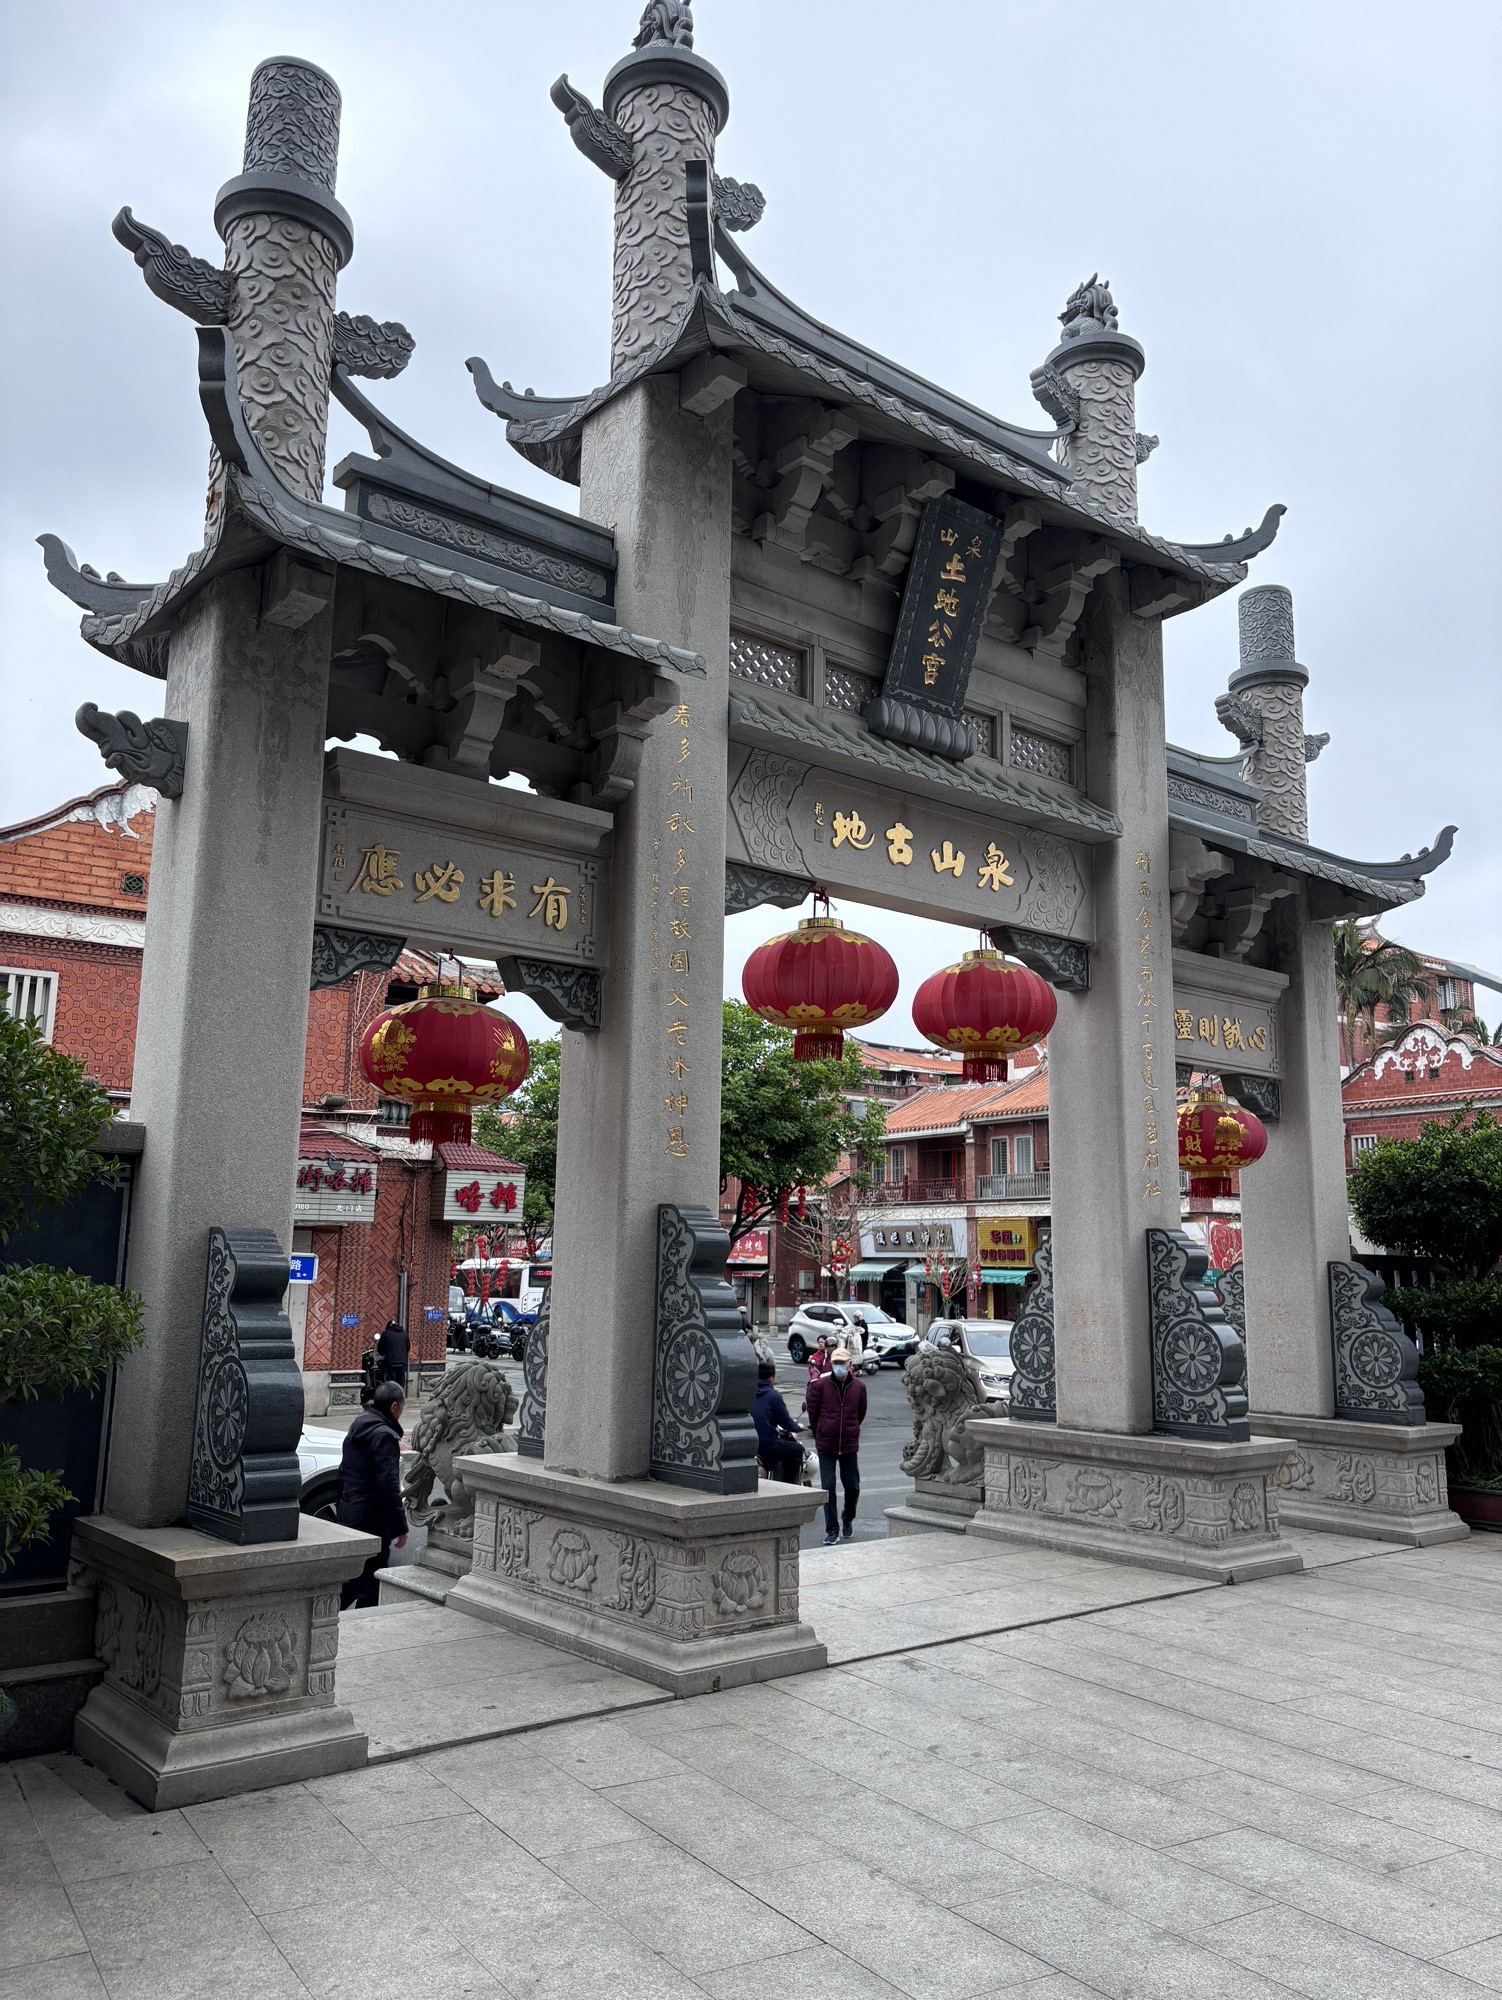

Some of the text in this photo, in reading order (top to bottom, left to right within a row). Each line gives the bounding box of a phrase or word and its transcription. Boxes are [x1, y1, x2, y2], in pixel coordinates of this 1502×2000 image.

[348, 844, 572, 931] 有求必應
[1174, 1009, 1267, 1052] 心誠則靈
